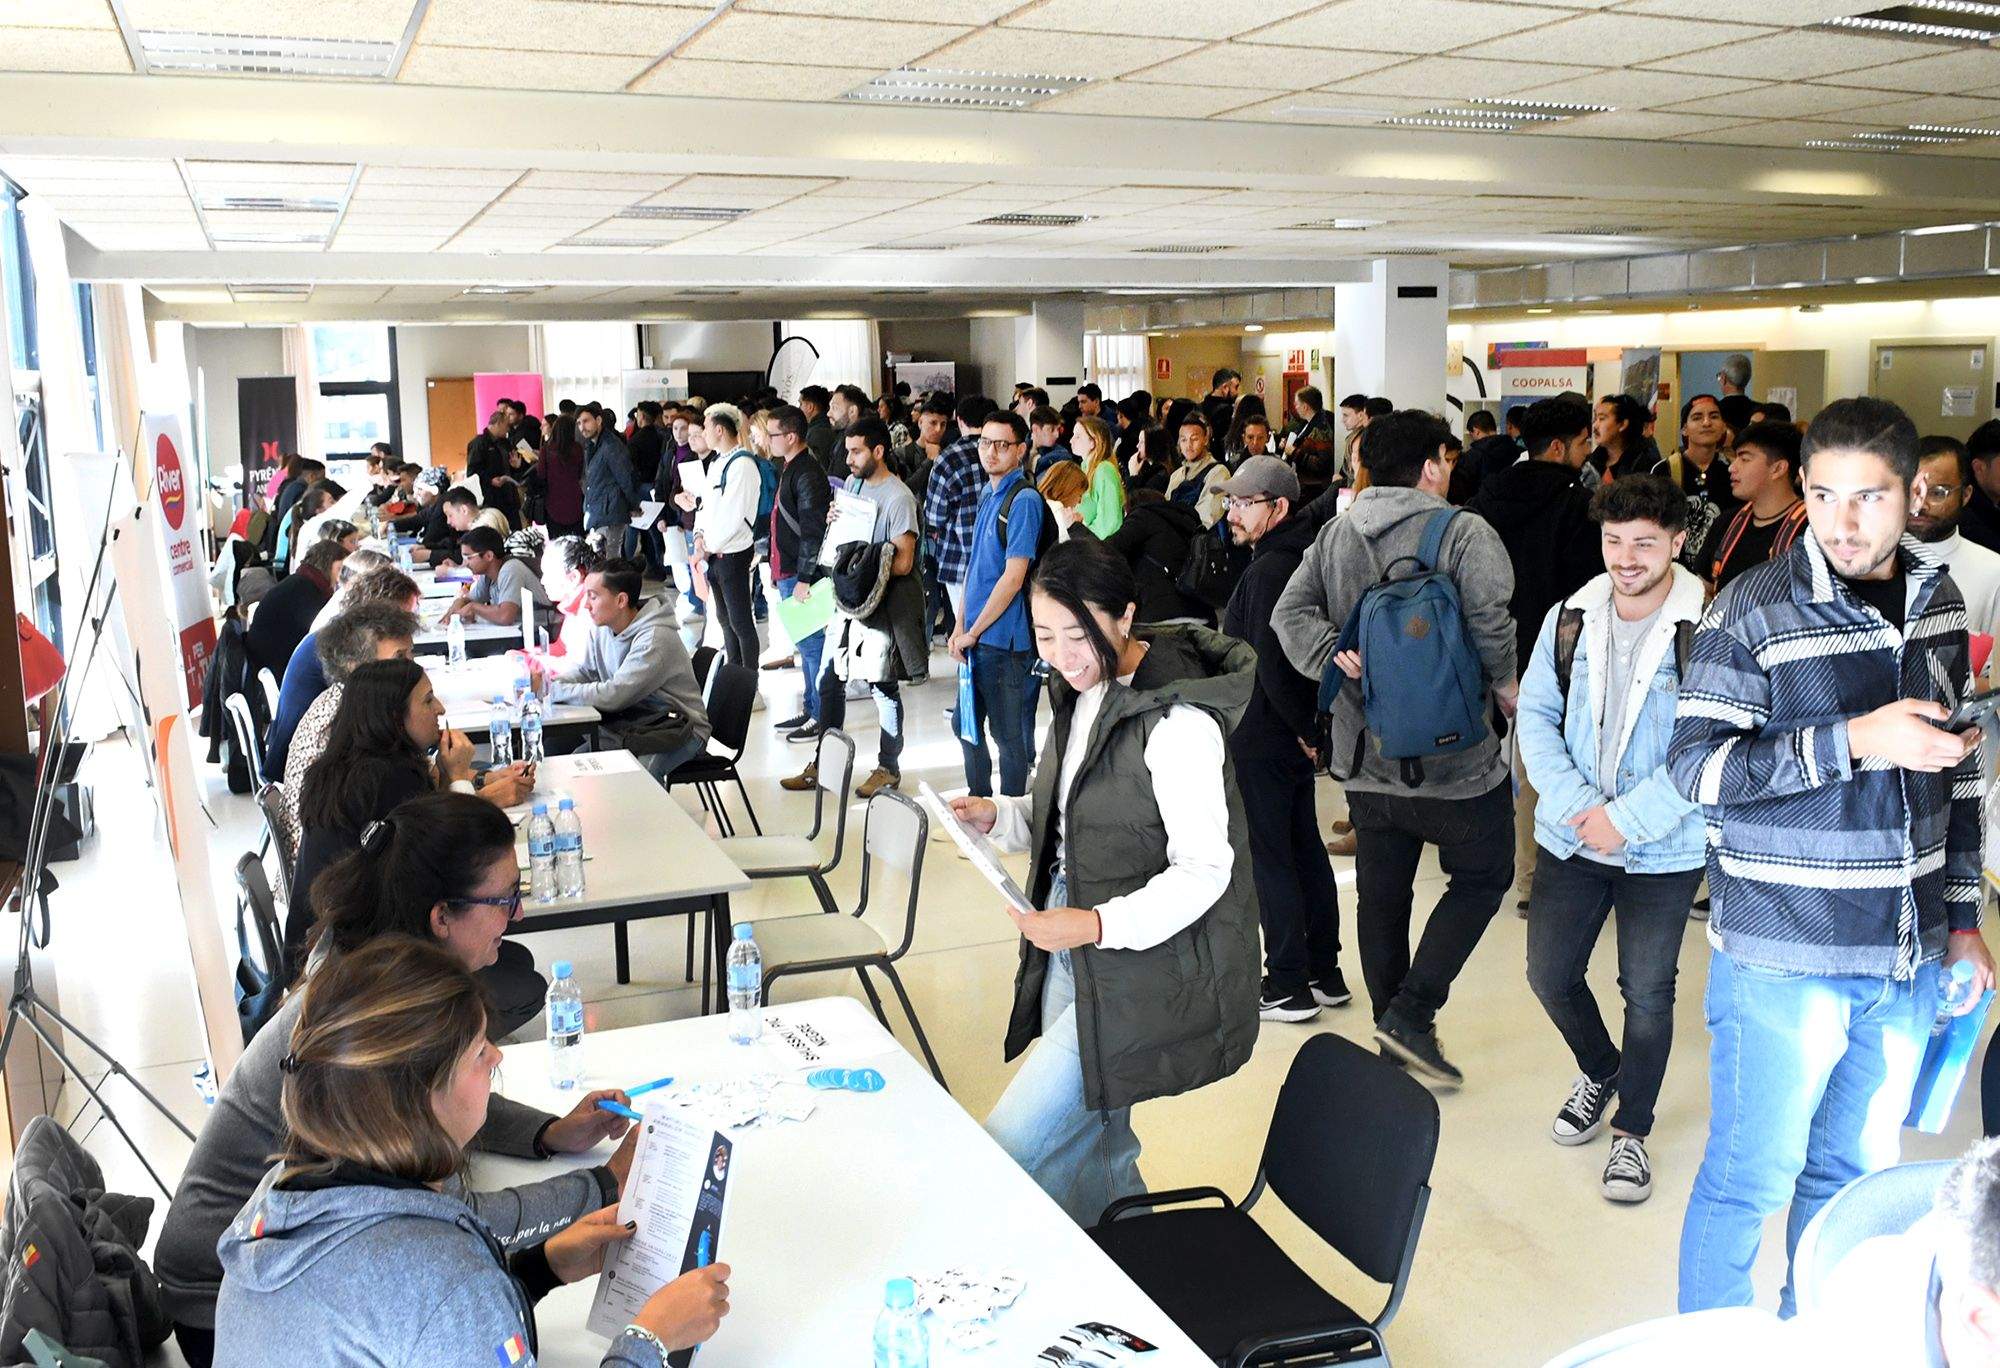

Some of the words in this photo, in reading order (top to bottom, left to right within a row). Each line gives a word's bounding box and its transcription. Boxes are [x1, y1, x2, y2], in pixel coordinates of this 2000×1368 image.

[1511, 378, 1573, 388] COOPALSA
[157, 464, 181, 494] River
[170, 540, 191, 560] centre
[515, 1226, 537, 1244] per
[539, 1221, 550, 1234] la
[553, 1216, 572, 1230] neu
